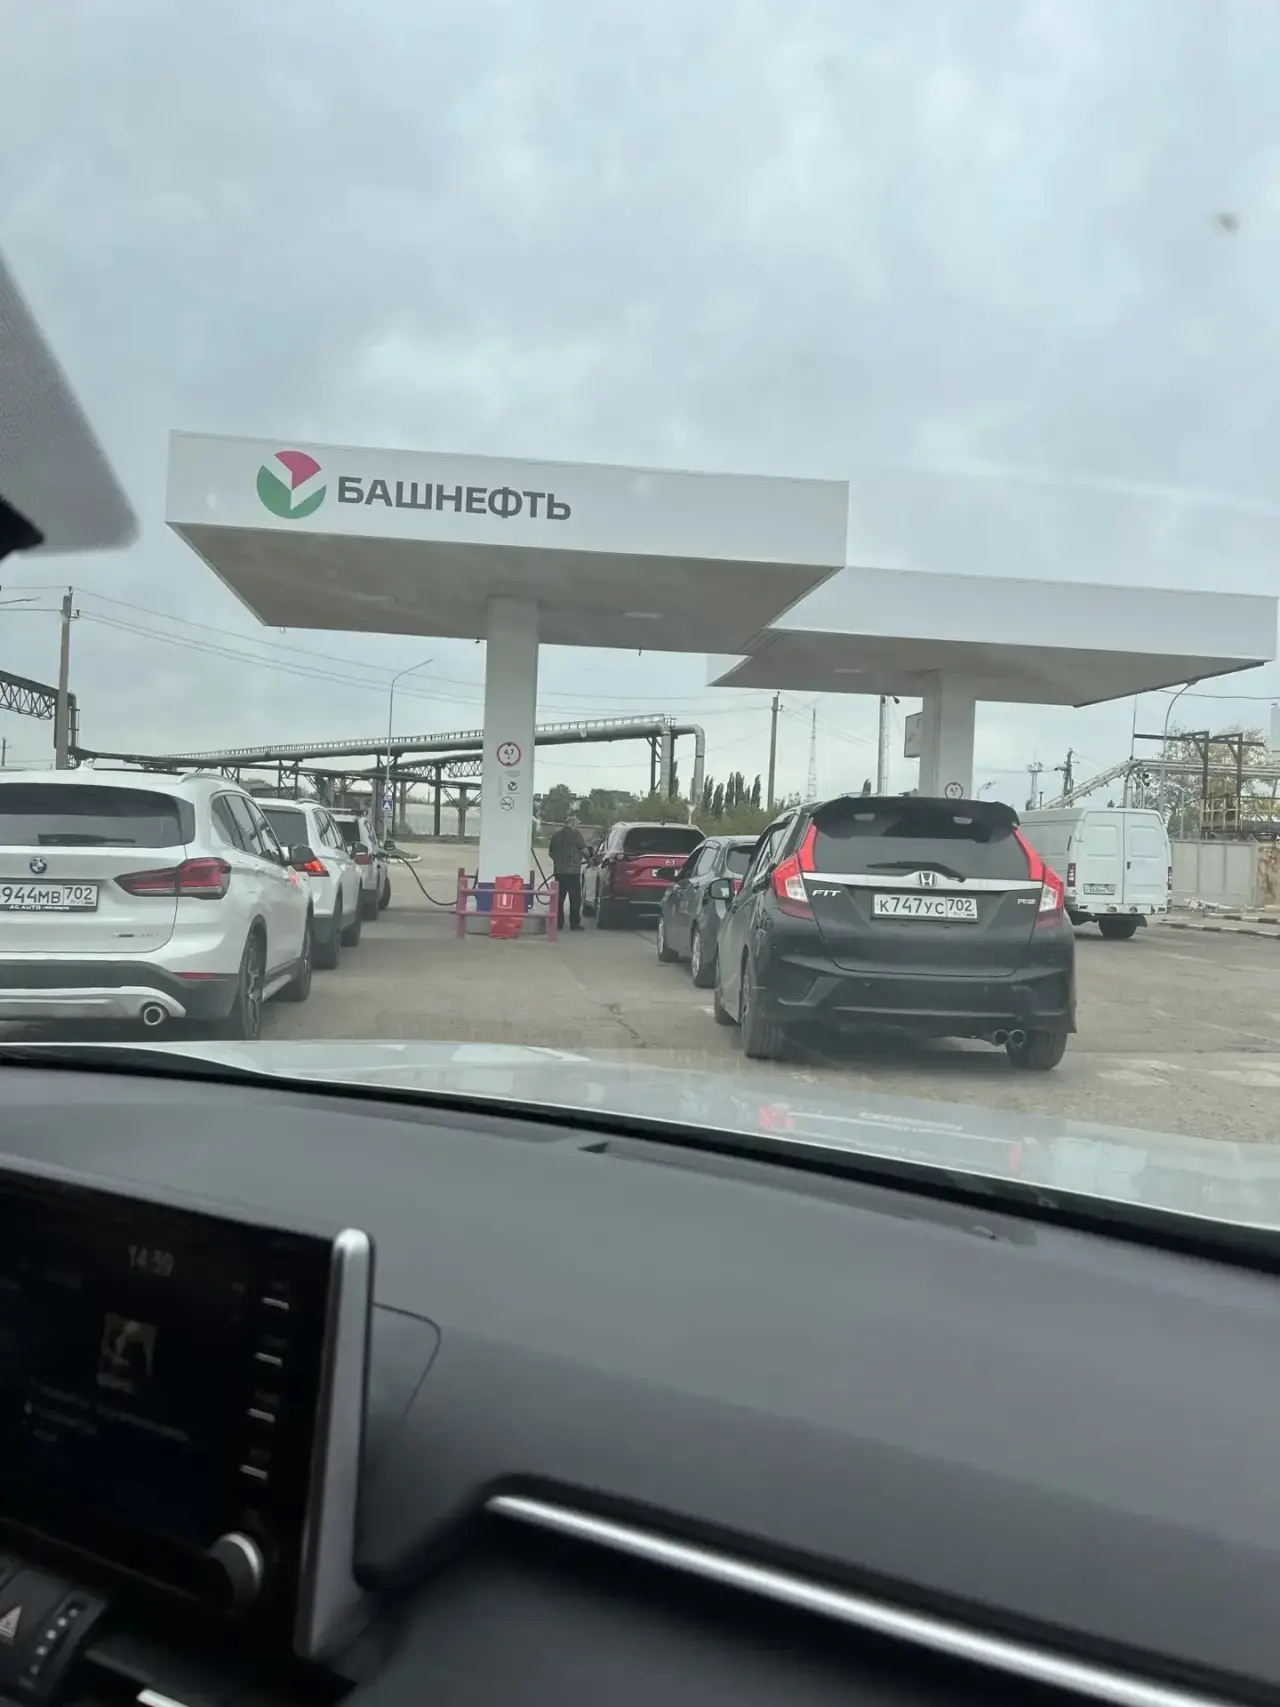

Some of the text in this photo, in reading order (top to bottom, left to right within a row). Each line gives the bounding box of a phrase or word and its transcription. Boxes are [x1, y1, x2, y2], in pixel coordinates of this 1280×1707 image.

[337, 475, 571, 521] БАШНЕФТЬ
[0, 886, 93, 904] 944МВ 702
[811, 889, 842, 897] FIT
[879, 897, 973, 915] К747УС 702
